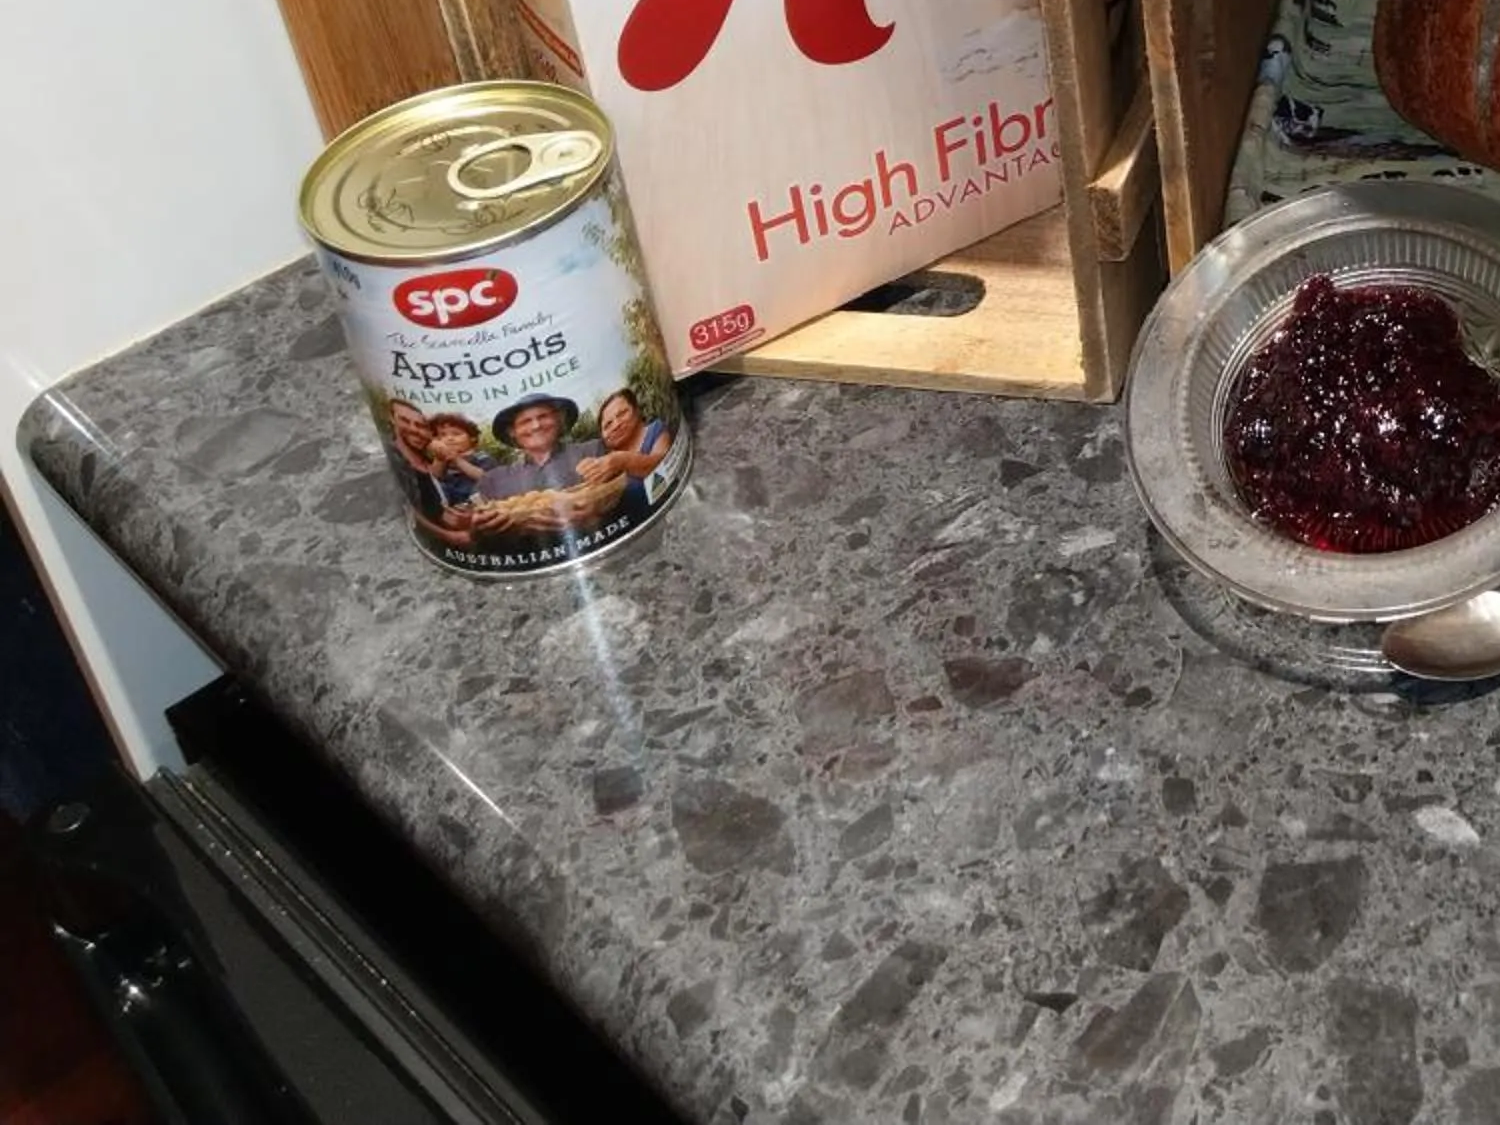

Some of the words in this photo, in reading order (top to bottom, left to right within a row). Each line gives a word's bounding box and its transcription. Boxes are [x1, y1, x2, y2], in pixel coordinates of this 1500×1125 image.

[748, 150, 919, 262] High
[934, 97, 1055, 182] Fibr
[889, 141, 1060, 236] ADVANTA
[407, 279, 498, 324] spc
[694, 311, 750, 345] 315g
[391, 331, 567, 388] Apricots
[394, 385, 473, 404] HALVED
[484, 384, 509, 401] IN
[519, 356, 581, 393] JUICE
[443, 545, 567, 567] AUSTRALIAN
[576, 514, 631, 551] MADE
